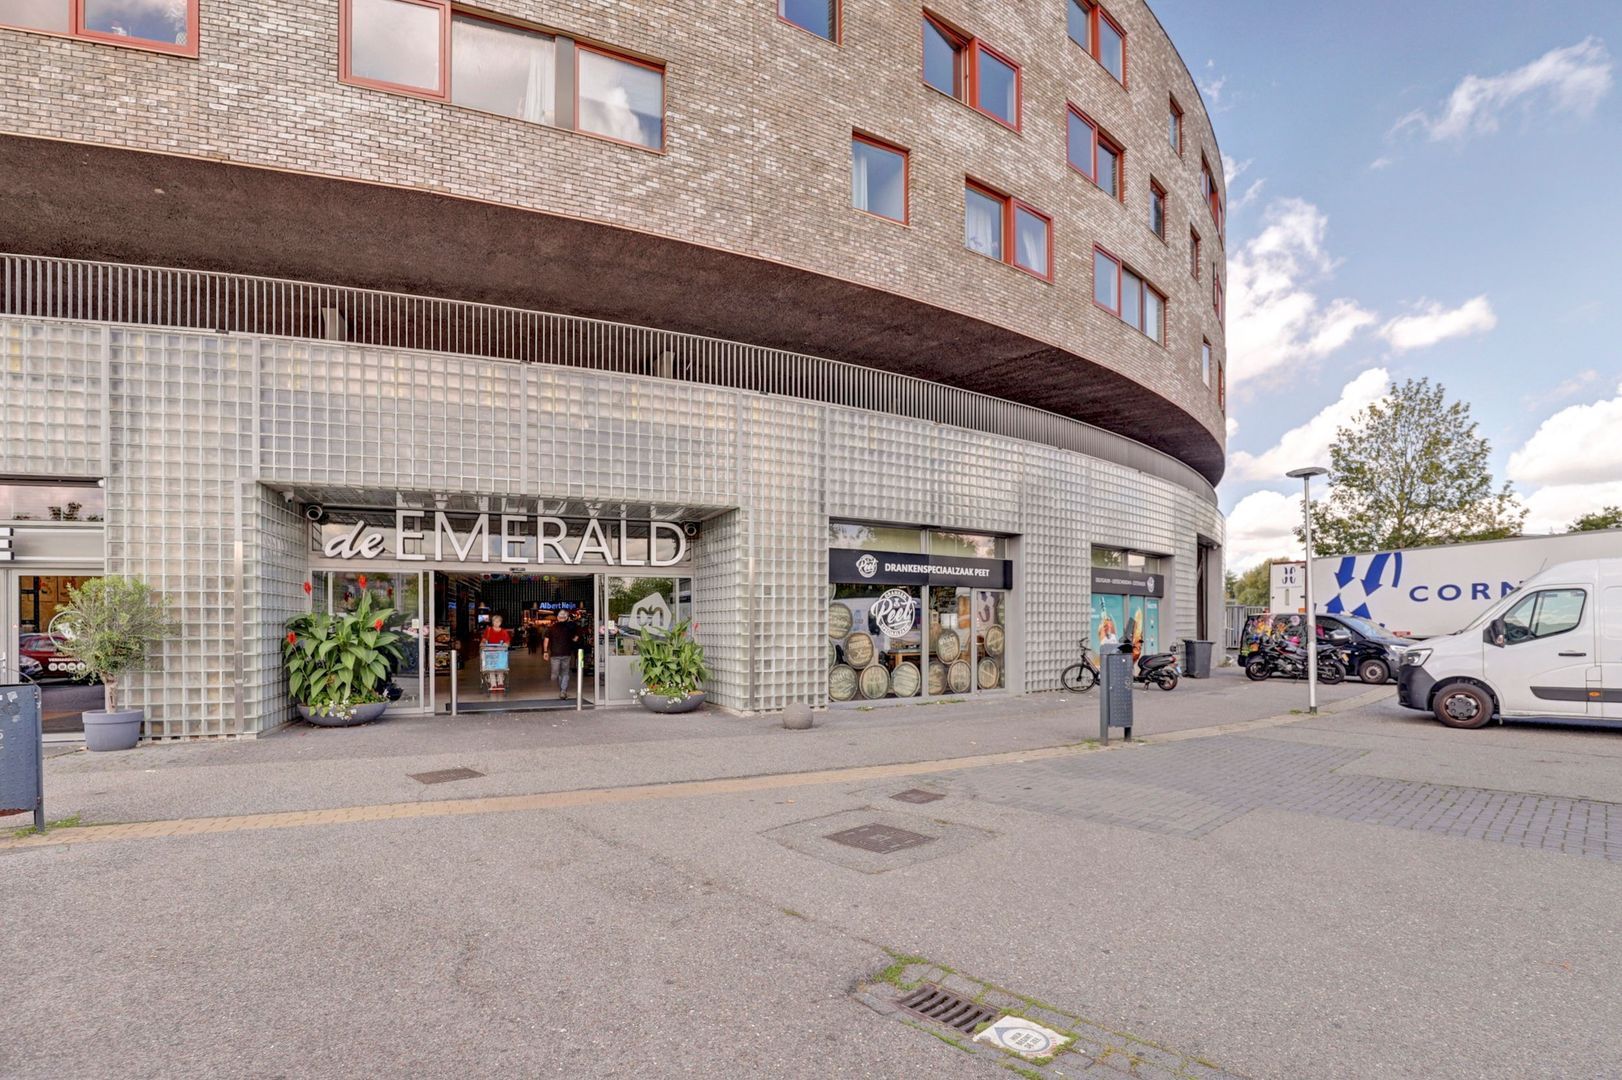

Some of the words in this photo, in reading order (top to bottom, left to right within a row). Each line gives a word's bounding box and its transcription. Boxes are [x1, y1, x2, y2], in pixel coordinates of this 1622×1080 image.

[325, 520, 385, 559] de
[396, 510, 687, 567] EMERALD
[884, 562, 974, 576] DRANKENSPECIAALZAAK
[974, 568, 990, 577] PEET
[871, 596, 917, 625] Peet
